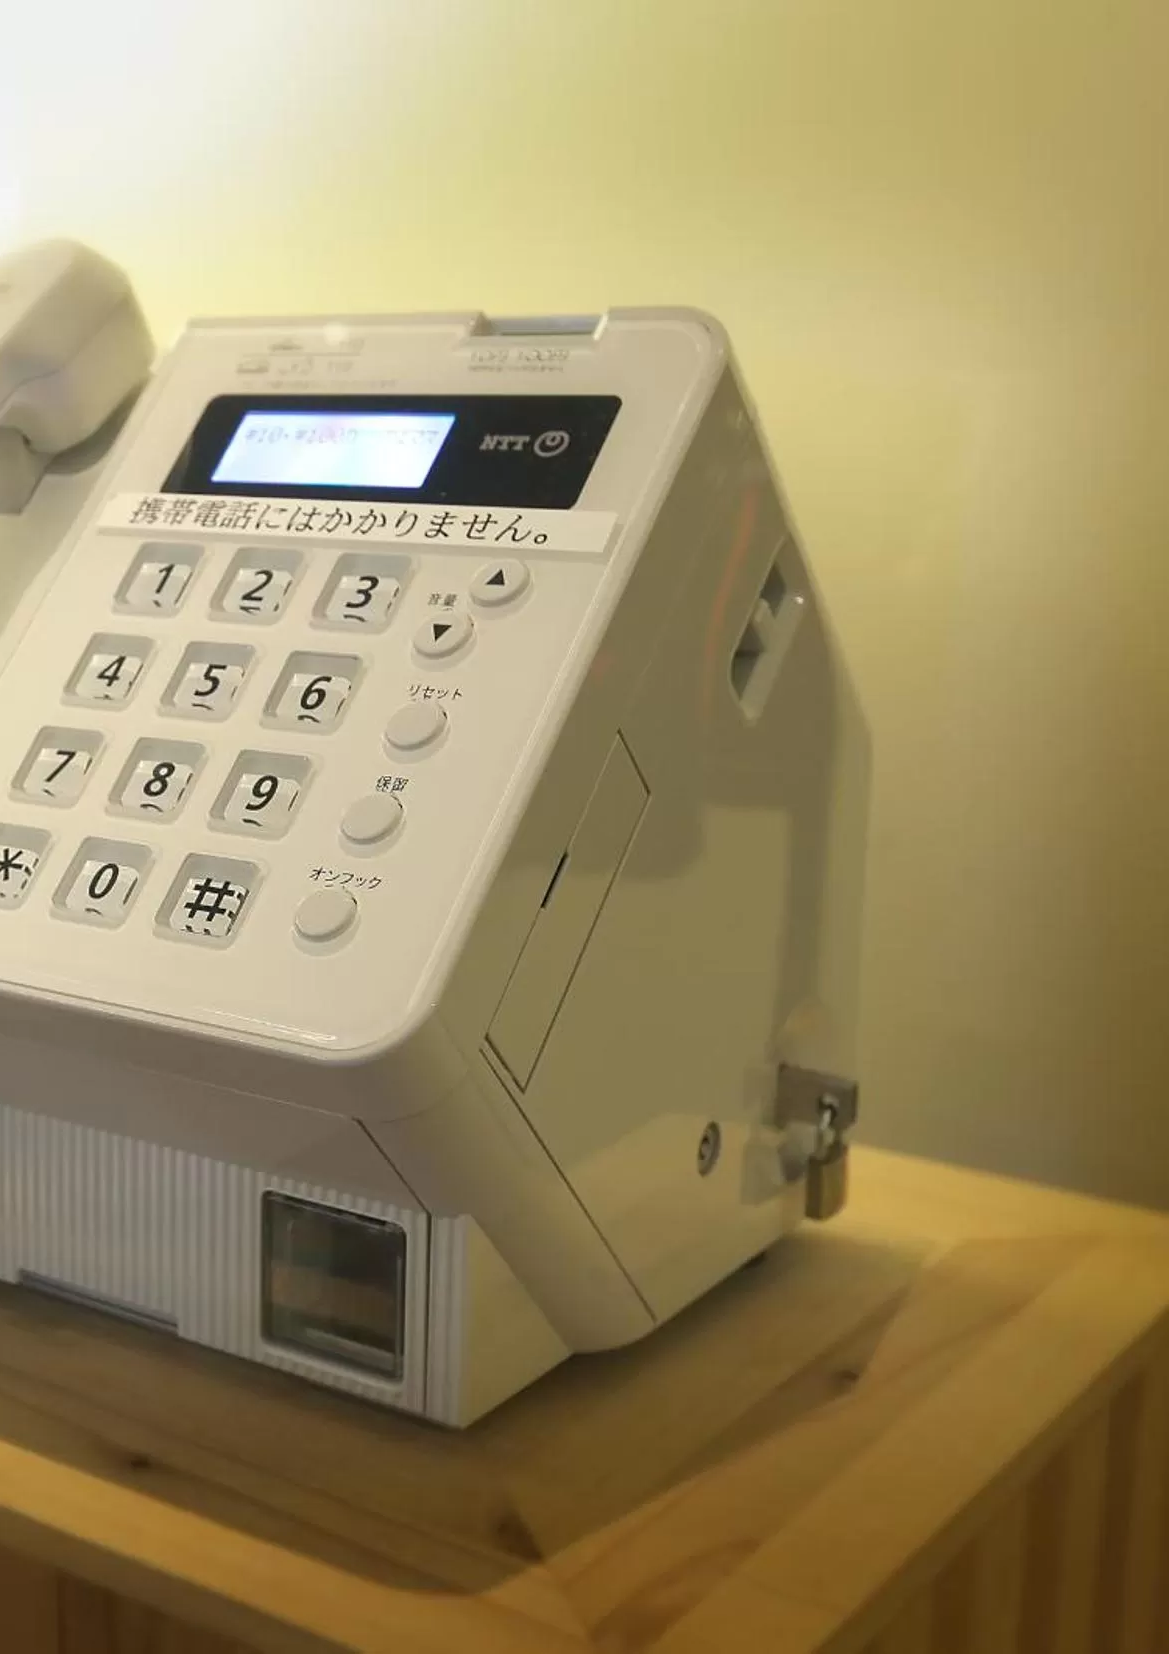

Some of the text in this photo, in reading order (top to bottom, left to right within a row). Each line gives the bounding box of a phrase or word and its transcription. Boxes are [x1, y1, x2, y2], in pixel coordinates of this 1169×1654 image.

[478, 433, 531, 451] NTT
[129, 496, 549, 545] 携帯電話にはかかりません。
[149, 563, 380, 610] 1 2 3
[427, 592, 458, 607] 音量
[97, 655, 332, 711] 4 5 6
[408, 684, 464, 700] リセット
[44, 752, 279, 813] 7 8 9
[375, 774, 410, 793] 保留
[88, 863, 120, 900] 0
[308, 866, 383, 890] オンフック
